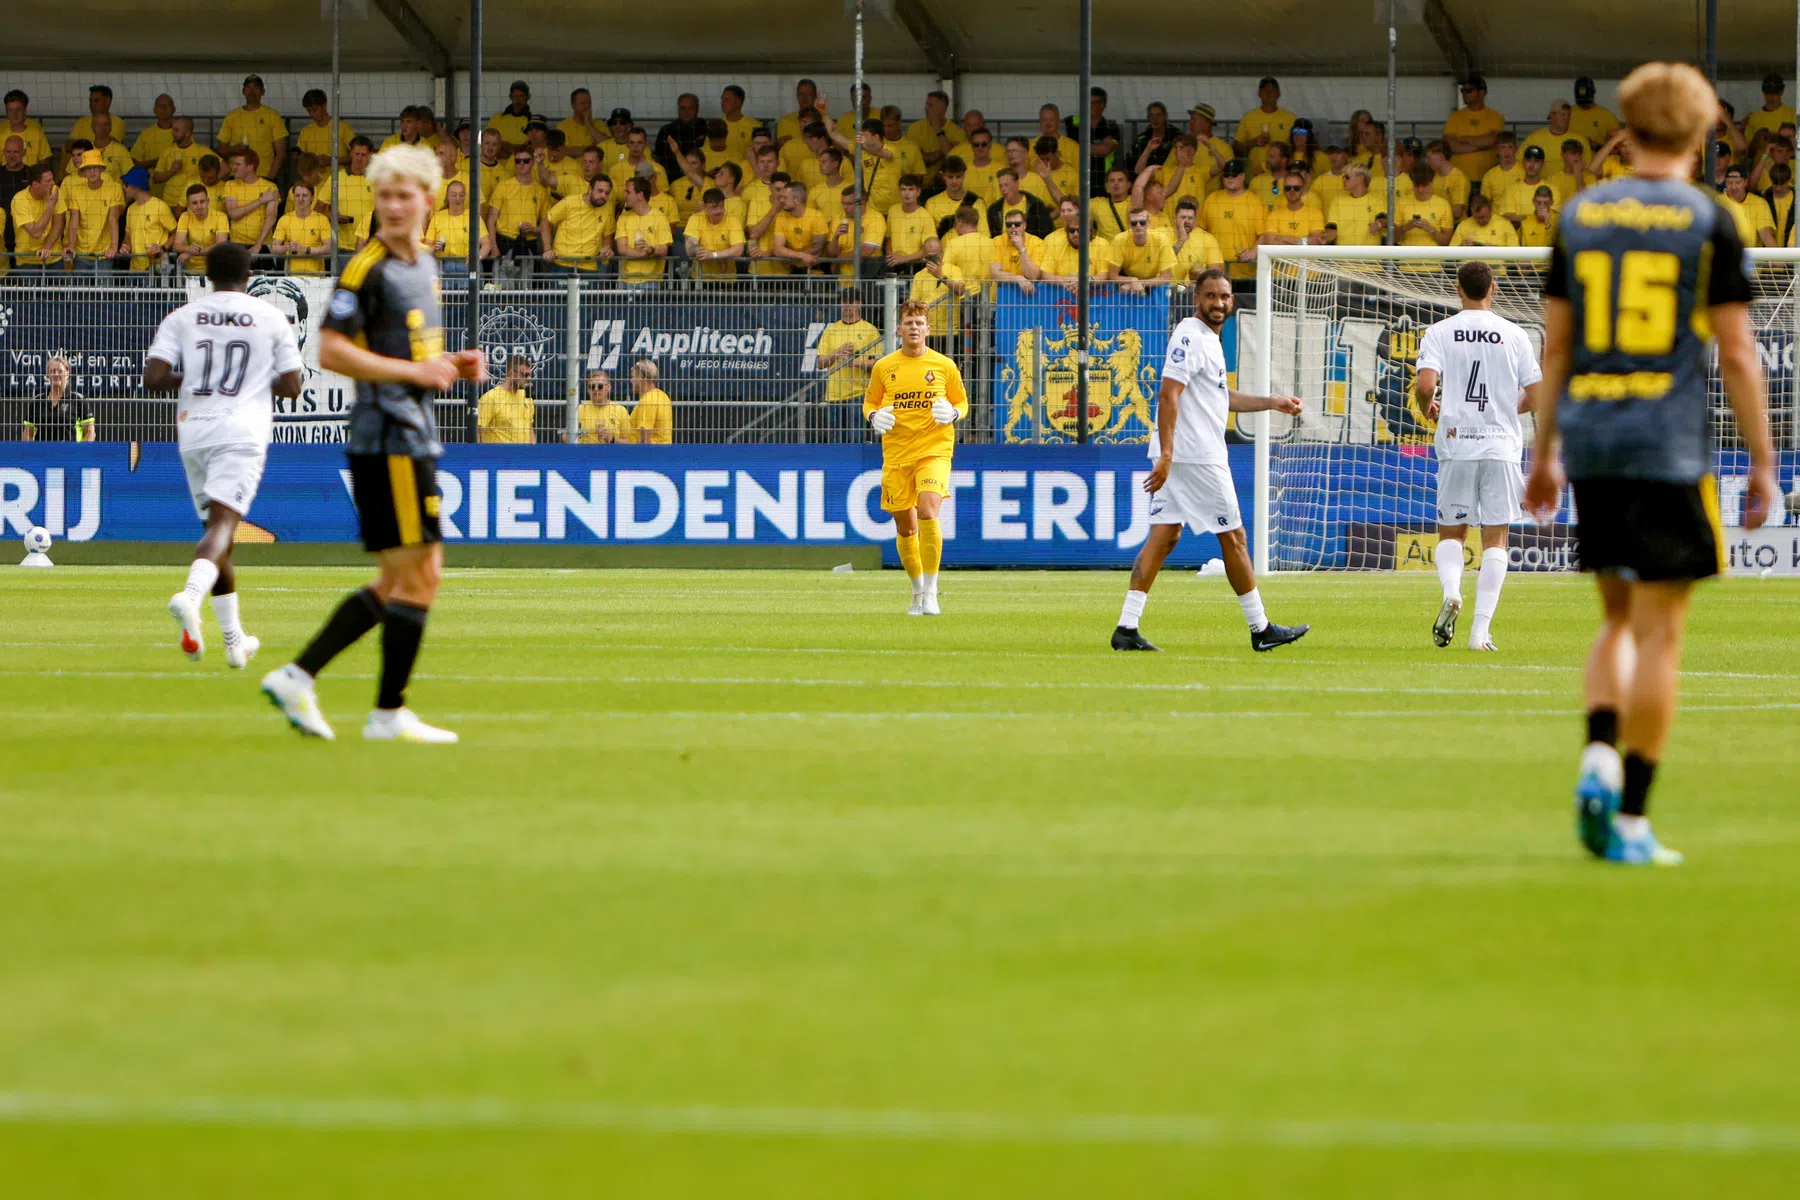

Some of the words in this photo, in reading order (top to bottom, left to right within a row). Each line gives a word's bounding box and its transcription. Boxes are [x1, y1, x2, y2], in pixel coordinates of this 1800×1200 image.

[1575, 250, 1680, 355] 15
[196, 312, 257, 327] BUKO.
[631, 326, 773, 359] Applitech
[1453, 329, 1504, 344] BUKO.
[11, 349, 42, 366] Van
[87, 355, 106, 367] en
[680, 359, 692, 368] BY
[694, 359, 720, 369] JECO
[722, 360, 769, 370] ENERGIES
[192, 339, 250, 397] 10
[10, 373, 145, 387] LASEDRIJ
[1465, 360, 1488, 412] 4
[894, 391, 922, 400] PORT
